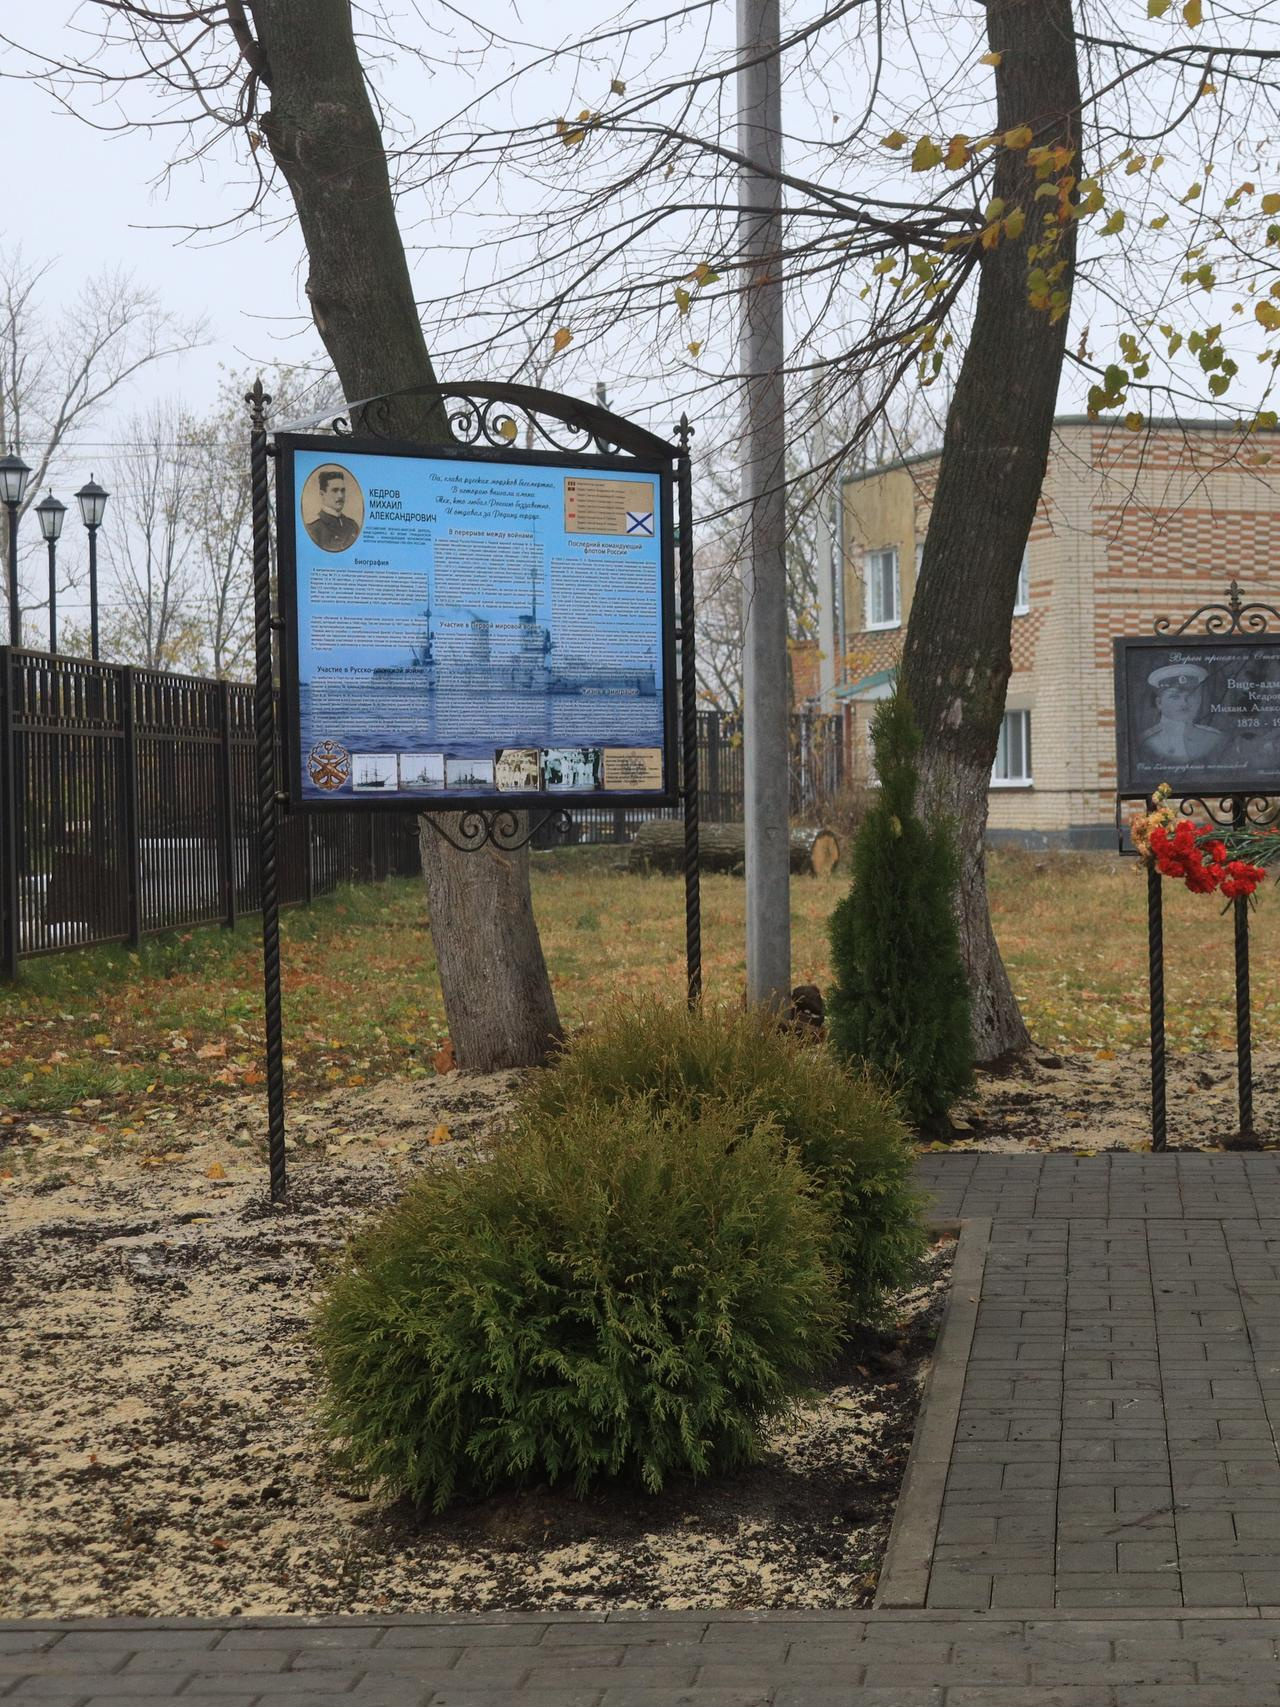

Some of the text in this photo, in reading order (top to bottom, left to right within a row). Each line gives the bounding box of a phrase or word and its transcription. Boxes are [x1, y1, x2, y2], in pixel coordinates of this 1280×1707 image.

[369, 488, 400, 498] КЕДРОВ
[369, 500, 402, 509] МИХАИЛ
[369, 511, 436, 522] АЛЕКСАНДРОВИЧ
[486, 531, 506, 539] между
[354, 558, 390, 566] Биография
[1210, 704, 1248, 712] Михаил
[1238, 718, 1260, 728] 1878
